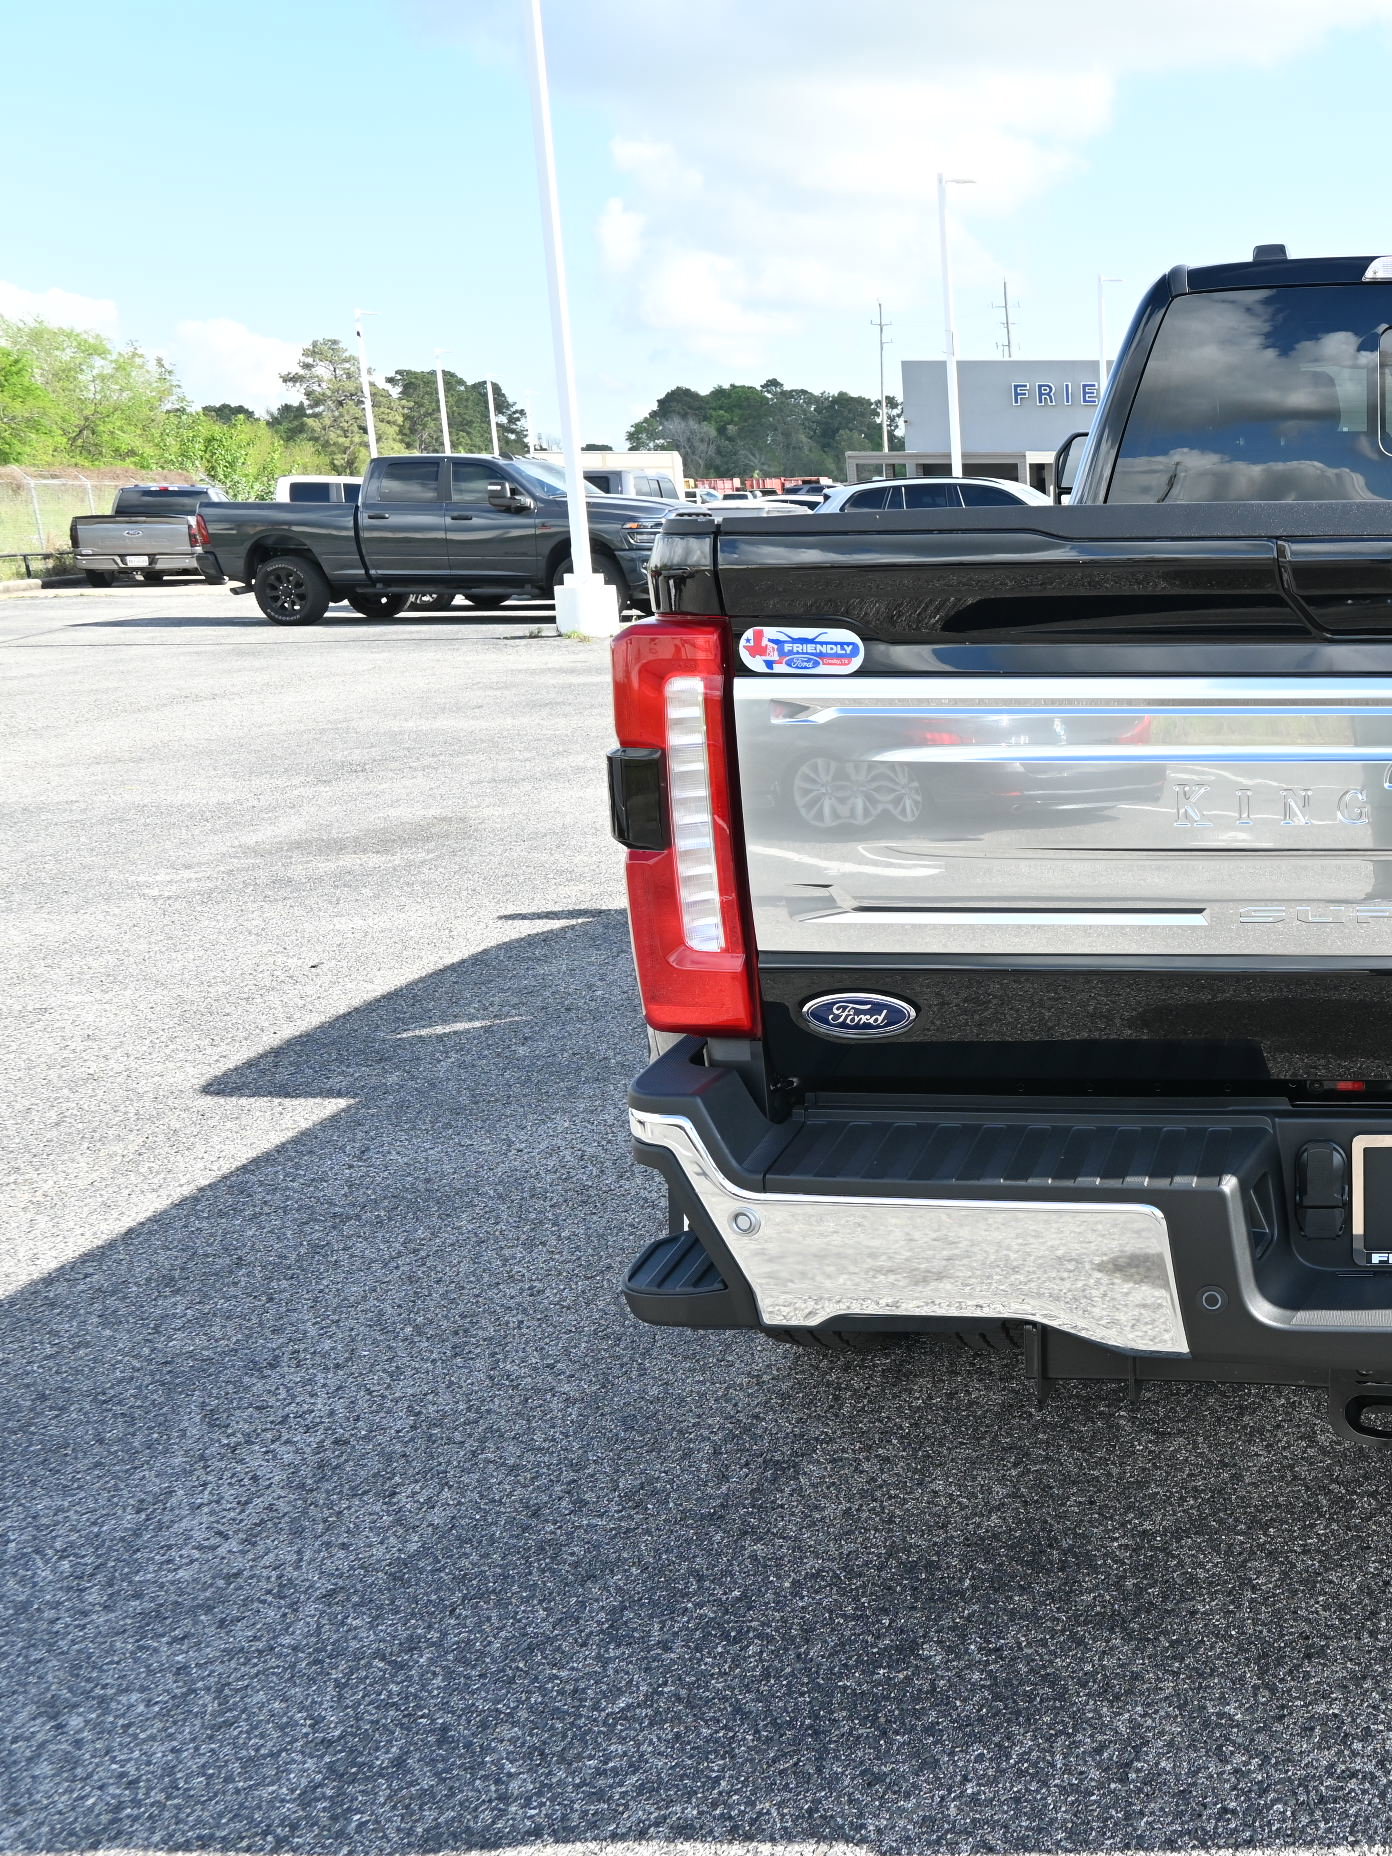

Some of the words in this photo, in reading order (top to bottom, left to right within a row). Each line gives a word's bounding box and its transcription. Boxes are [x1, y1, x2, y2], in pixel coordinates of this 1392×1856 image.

[1011, 382, 1098, 405] FRIE
[784, 643, 854, 655] FRIENDLY
[791, 657, 814, 668] Ford
[1173, 783, 1369, 827] KING
[829, 1002, 888, 1026] Ford
